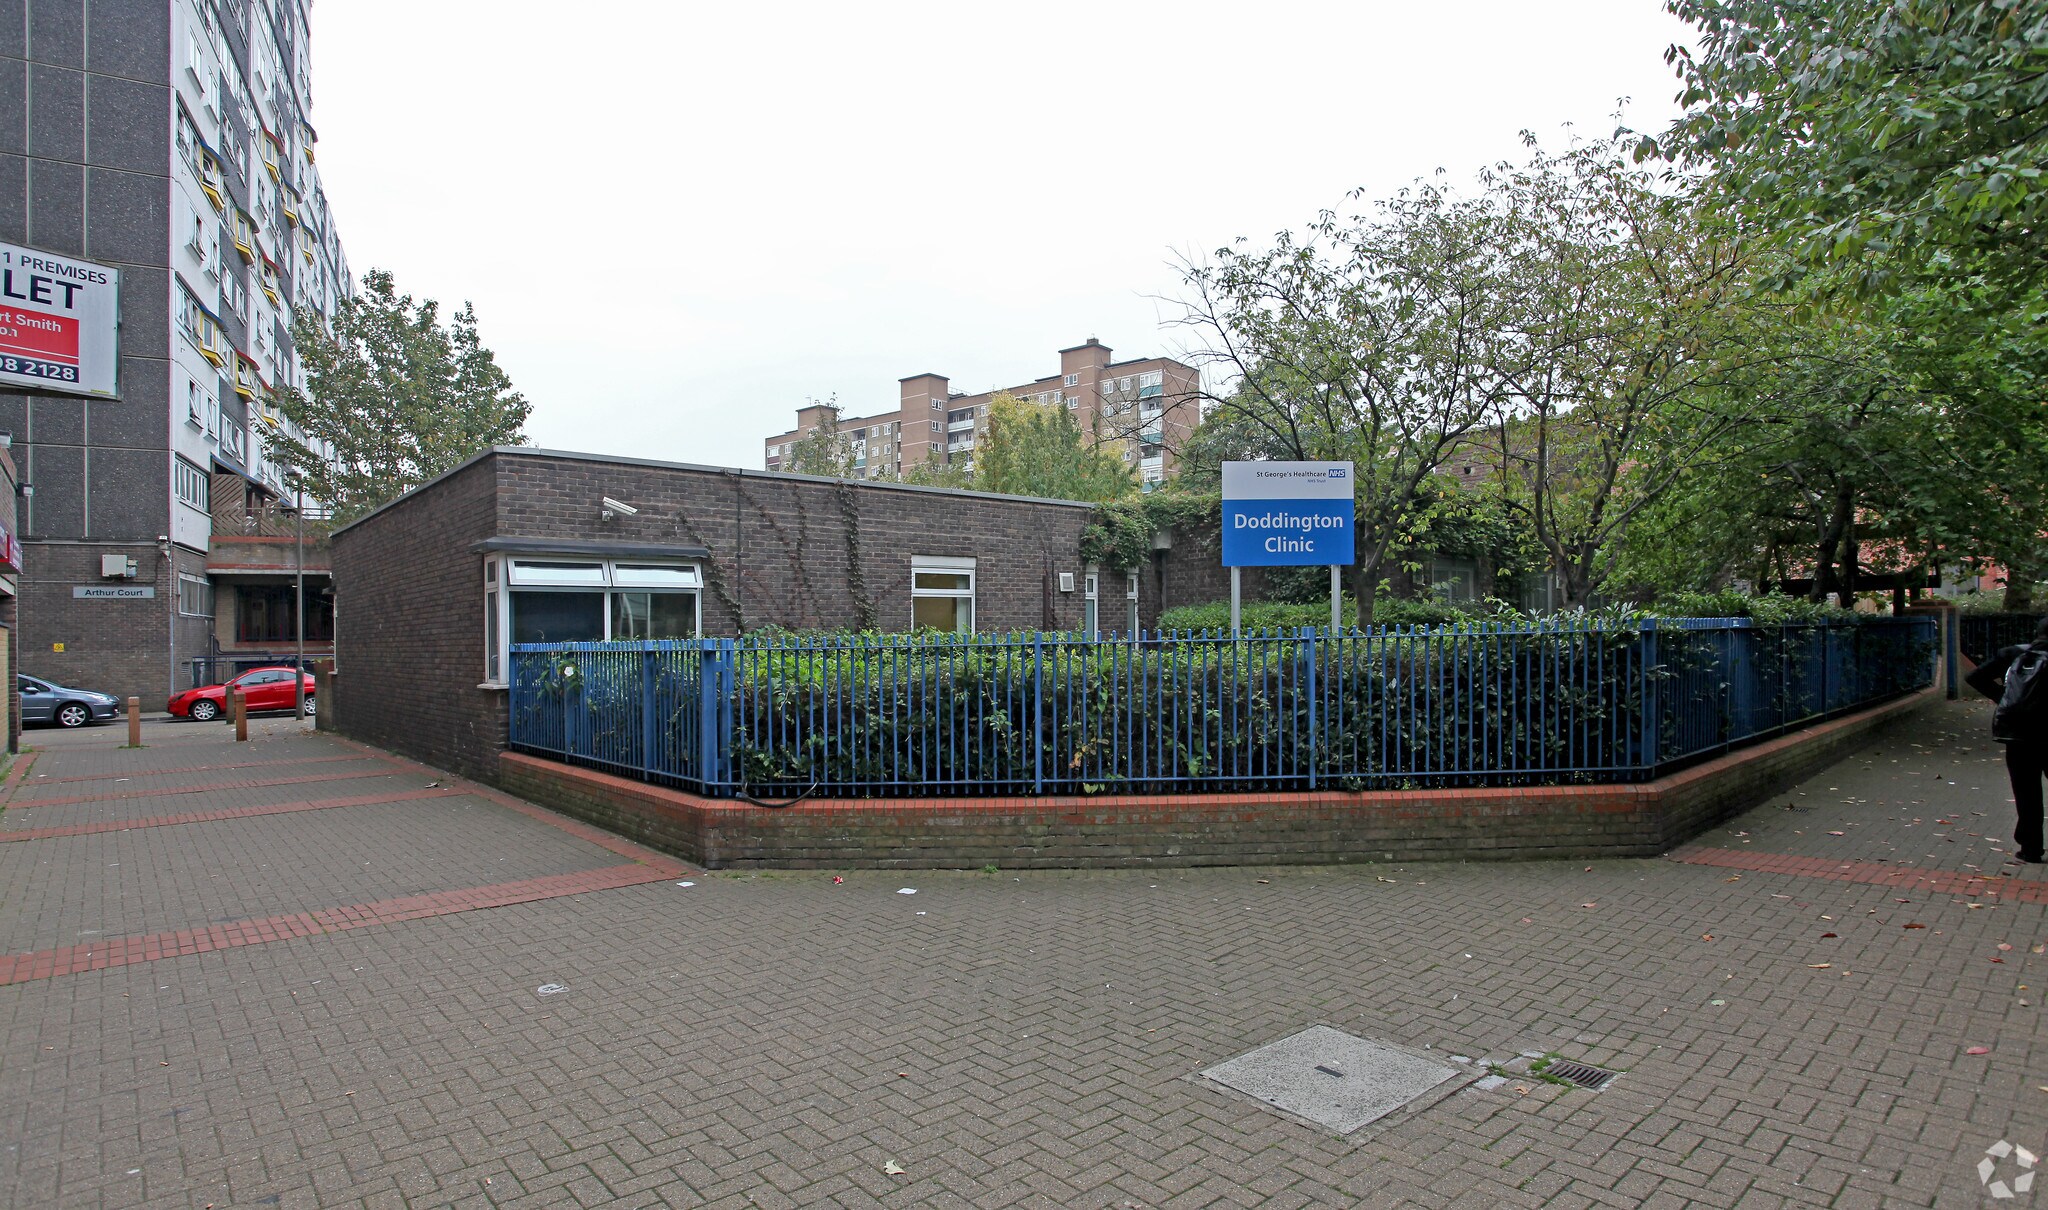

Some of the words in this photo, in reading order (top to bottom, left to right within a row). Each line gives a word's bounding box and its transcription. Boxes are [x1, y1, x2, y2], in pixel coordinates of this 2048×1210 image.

[21, 255, 107, 285] PREMISES
[3, 268, 84, 310] LET
[16, 314, 62, 333] Smith
[24, 361, 75, 381] 2128
[1264, 471, 1292, 479] George's
[1293, 470, 1327, 478] Healthcare
[1329, 469, 1346, 478] NHS
[1234, 512, 1344, 532] Doddington
[1264, 536, 1314, 553] Clinic
[84, 589, 115, 597] Arthur
[117, 589, 143, 597] Court
